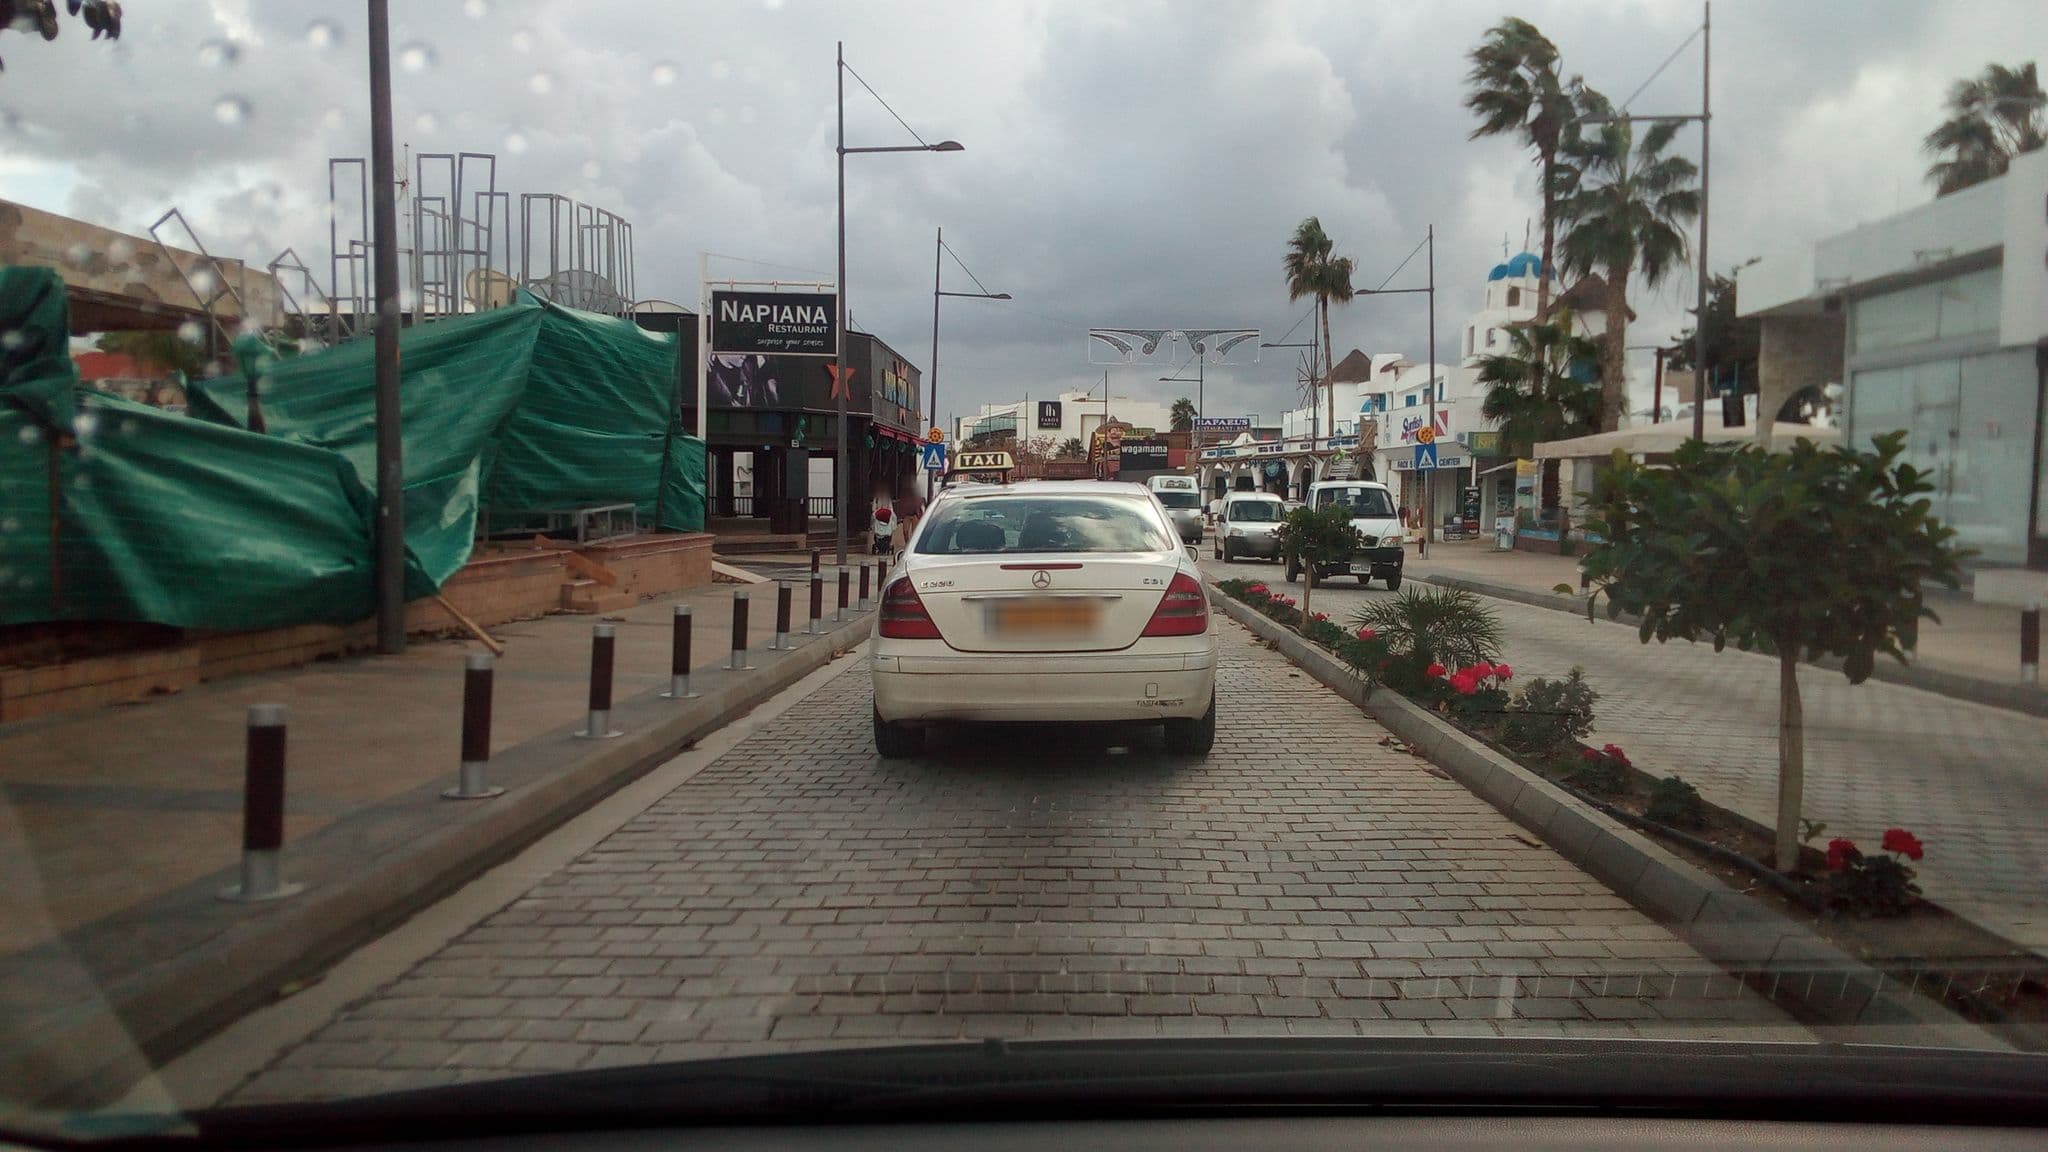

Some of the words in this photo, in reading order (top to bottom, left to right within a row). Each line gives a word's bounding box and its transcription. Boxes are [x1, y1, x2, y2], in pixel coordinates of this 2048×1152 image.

[721, 300, 828, 324] NAPIANA
[768, 324, 828, 334] RESTAURANT
[786, 339, 801, 349] your
[1121, 445, 1168, 455] wagamama
[963, 455, 1001, 466] TAXI
